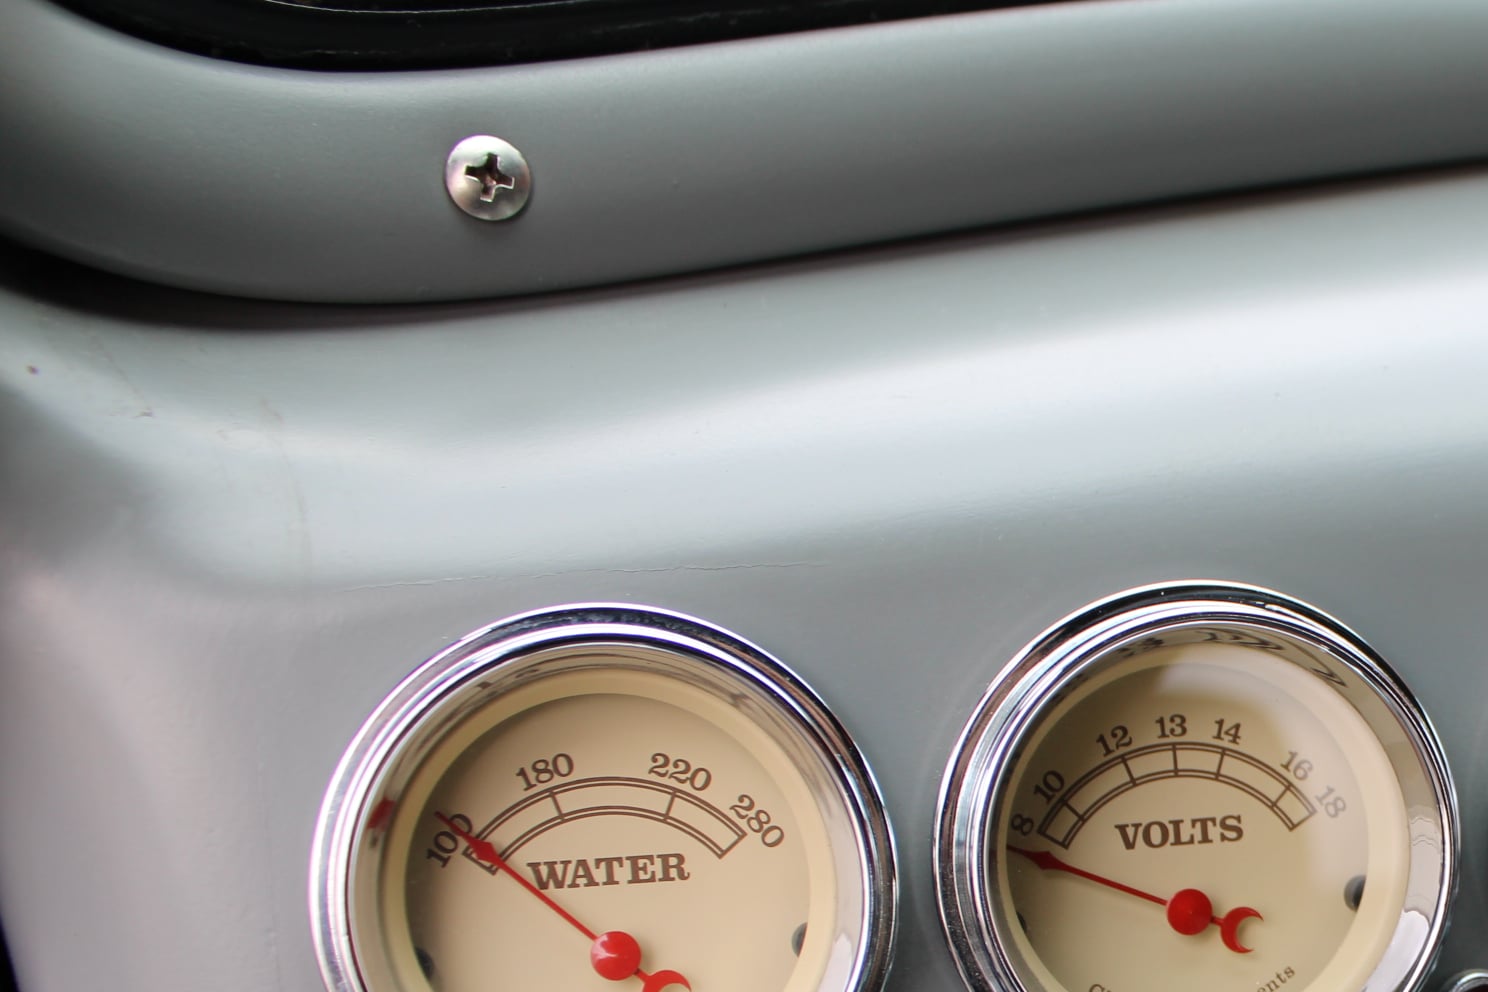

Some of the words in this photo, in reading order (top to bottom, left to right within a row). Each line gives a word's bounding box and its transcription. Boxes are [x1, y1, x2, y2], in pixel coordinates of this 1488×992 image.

[426, 813, 474, 868] 100
[515, 753, 574, 791] 180
[648, 752, 712, 791] 220
[729, 794, 785, 848] 280
[1010, 813, 1035, 837] 8
[1033, 769, 1065, 805] 10
[1095, 724, 1133, 757] 12
[1155, 714, 1188, 739] 13
[1212, 718, 1242, 745] 14
[1280, 750, 1314, 782] 16
[1314, 785, 1347, 819] 18
[1114, 814, 1244, 850] VOLTS
[527, 853, 690, 890] WATER
